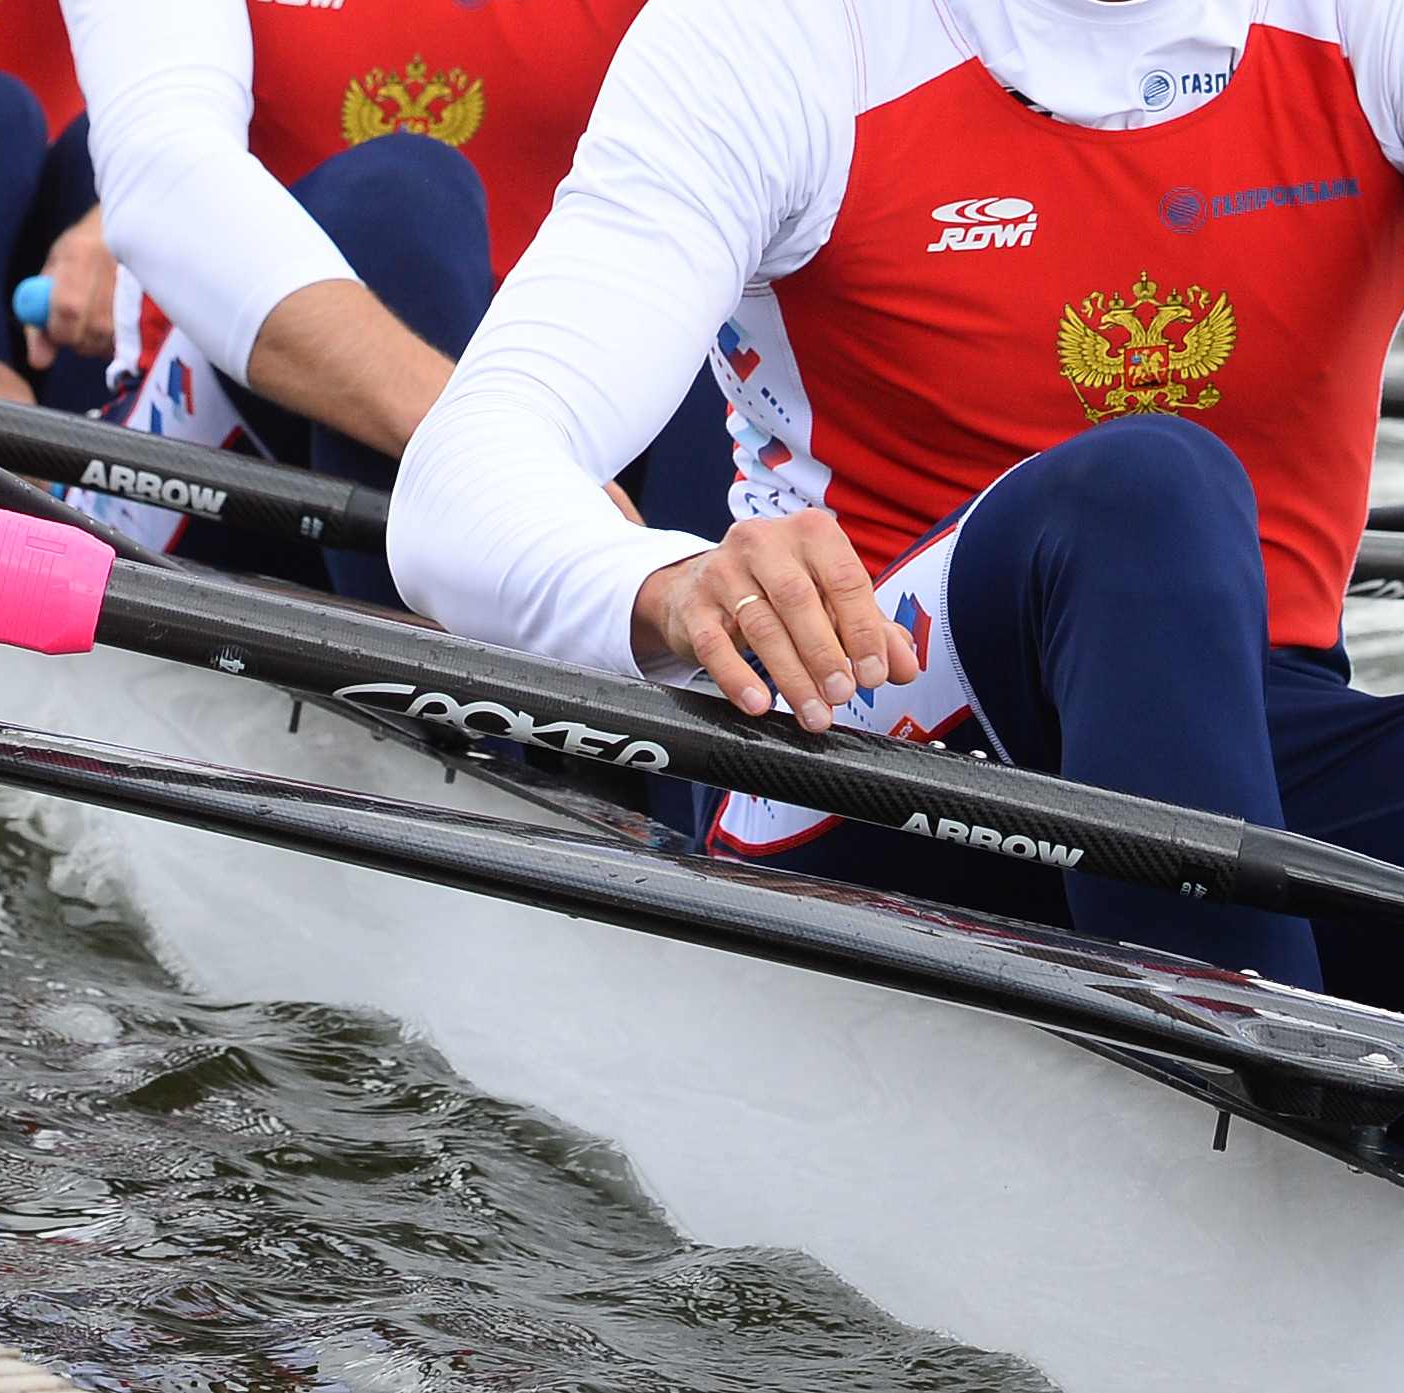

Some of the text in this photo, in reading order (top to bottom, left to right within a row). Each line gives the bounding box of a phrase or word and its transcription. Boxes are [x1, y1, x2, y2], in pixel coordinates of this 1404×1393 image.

[1211, 176, 1363, 219] ГАЗПРОМБАНК
[80, 459, 228, 513] ARROW
[332, 682, 670, 773] CROKER
[900, 812, 1085, 868] ARROW
